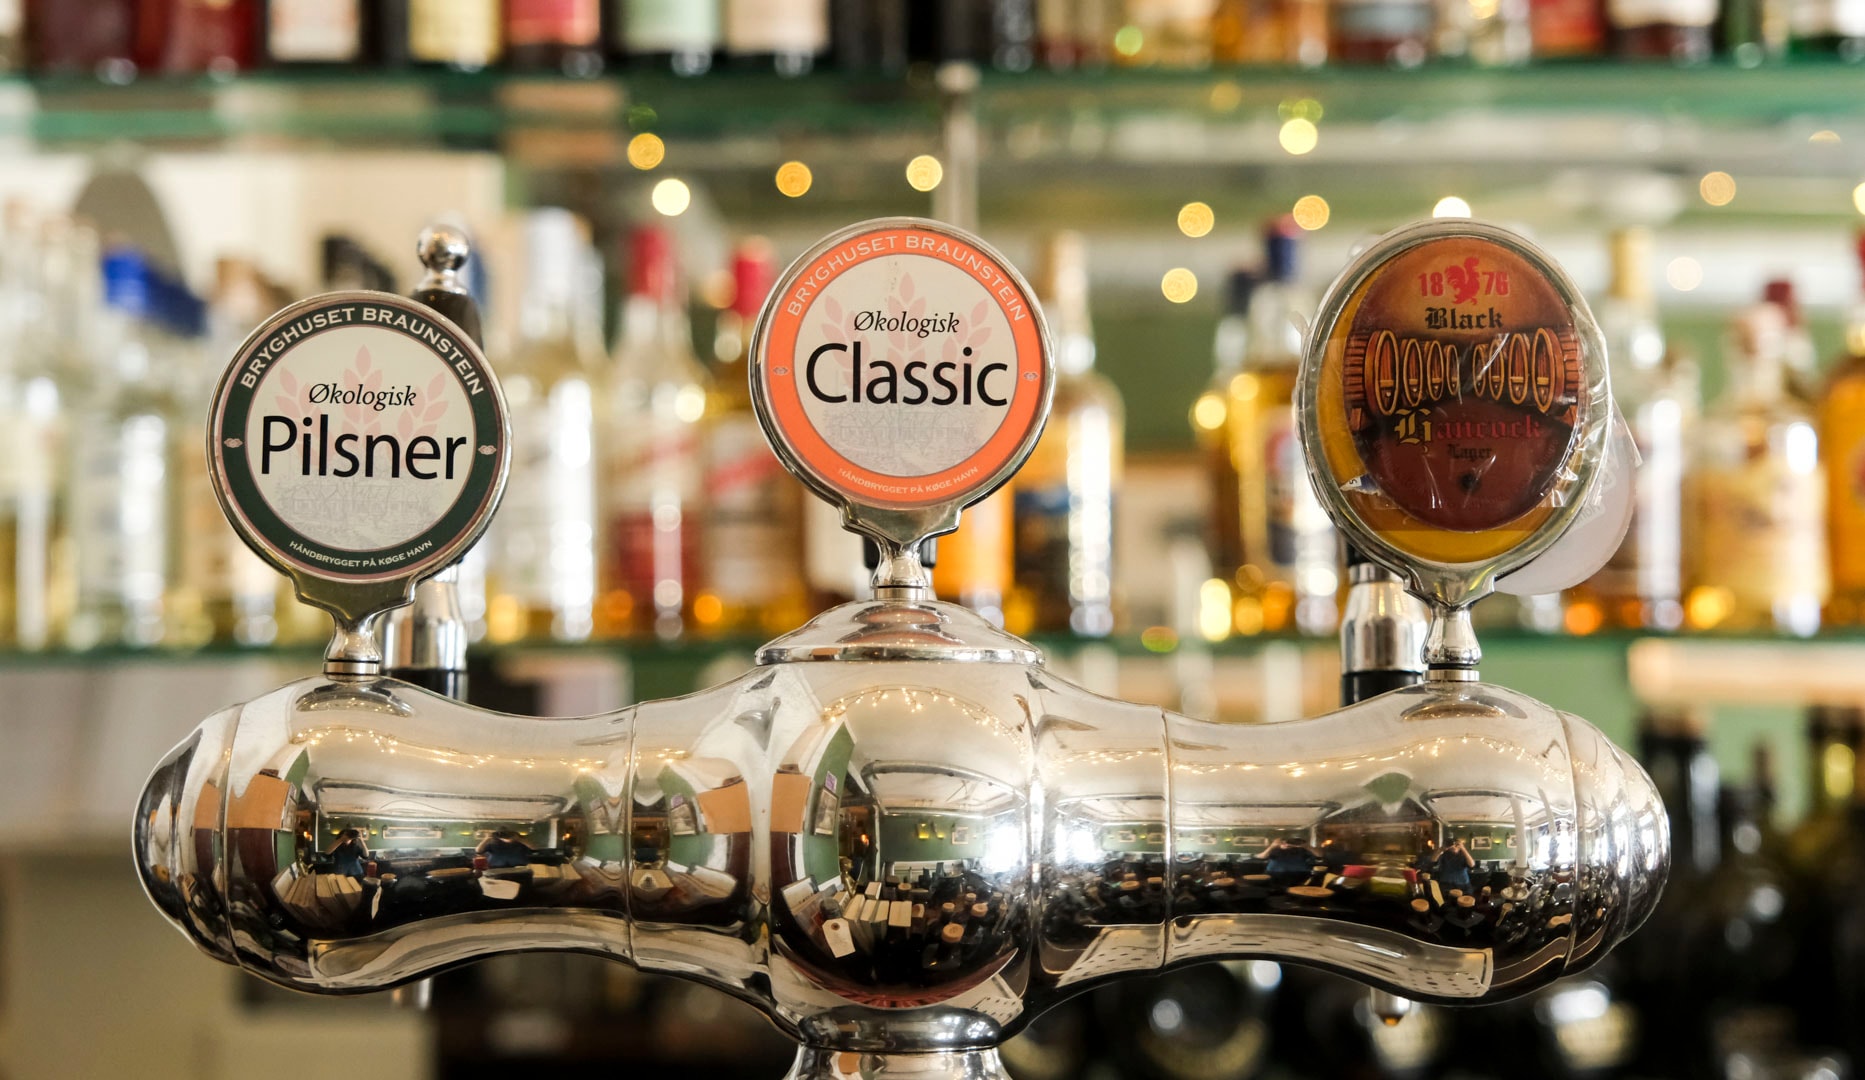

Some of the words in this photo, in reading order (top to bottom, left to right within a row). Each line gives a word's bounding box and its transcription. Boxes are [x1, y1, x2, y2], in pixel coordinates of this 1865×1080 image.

[787, 235, 898, 316] BRYGHUSET
[905, 235, 1026, 321] BRAUNSTEIN
[853, 311, 960, 338] Økologisk
[1424, 306, 1504, 330] Black
[240, 307, 355, 390] BRYGHUSET
[362, 307, 484, 396] BRAUNSTEIN
[806, 341, 1008, 407] Classic
[308, 383, 417, 411] Økologisk
[1394, 408, 1542, 446] Hancock
[261, 414, 467, 480] Pilsner
[1448, 444, 1492, 461] Lager
[838, 468, 907, 494] HÅNDBRYGGET
[910, 484, 923, 494] PÅ
[925, 479, 952, 492] KØGE
[953, 466, 979, 484] HAVN
[289, 540, 360, 567] HÅNDBRYGGET
[362, 557, 377, 568] PÅ
[378, 552, 406, 567] KØGE
[406, 540, 433, 558] HAVN
